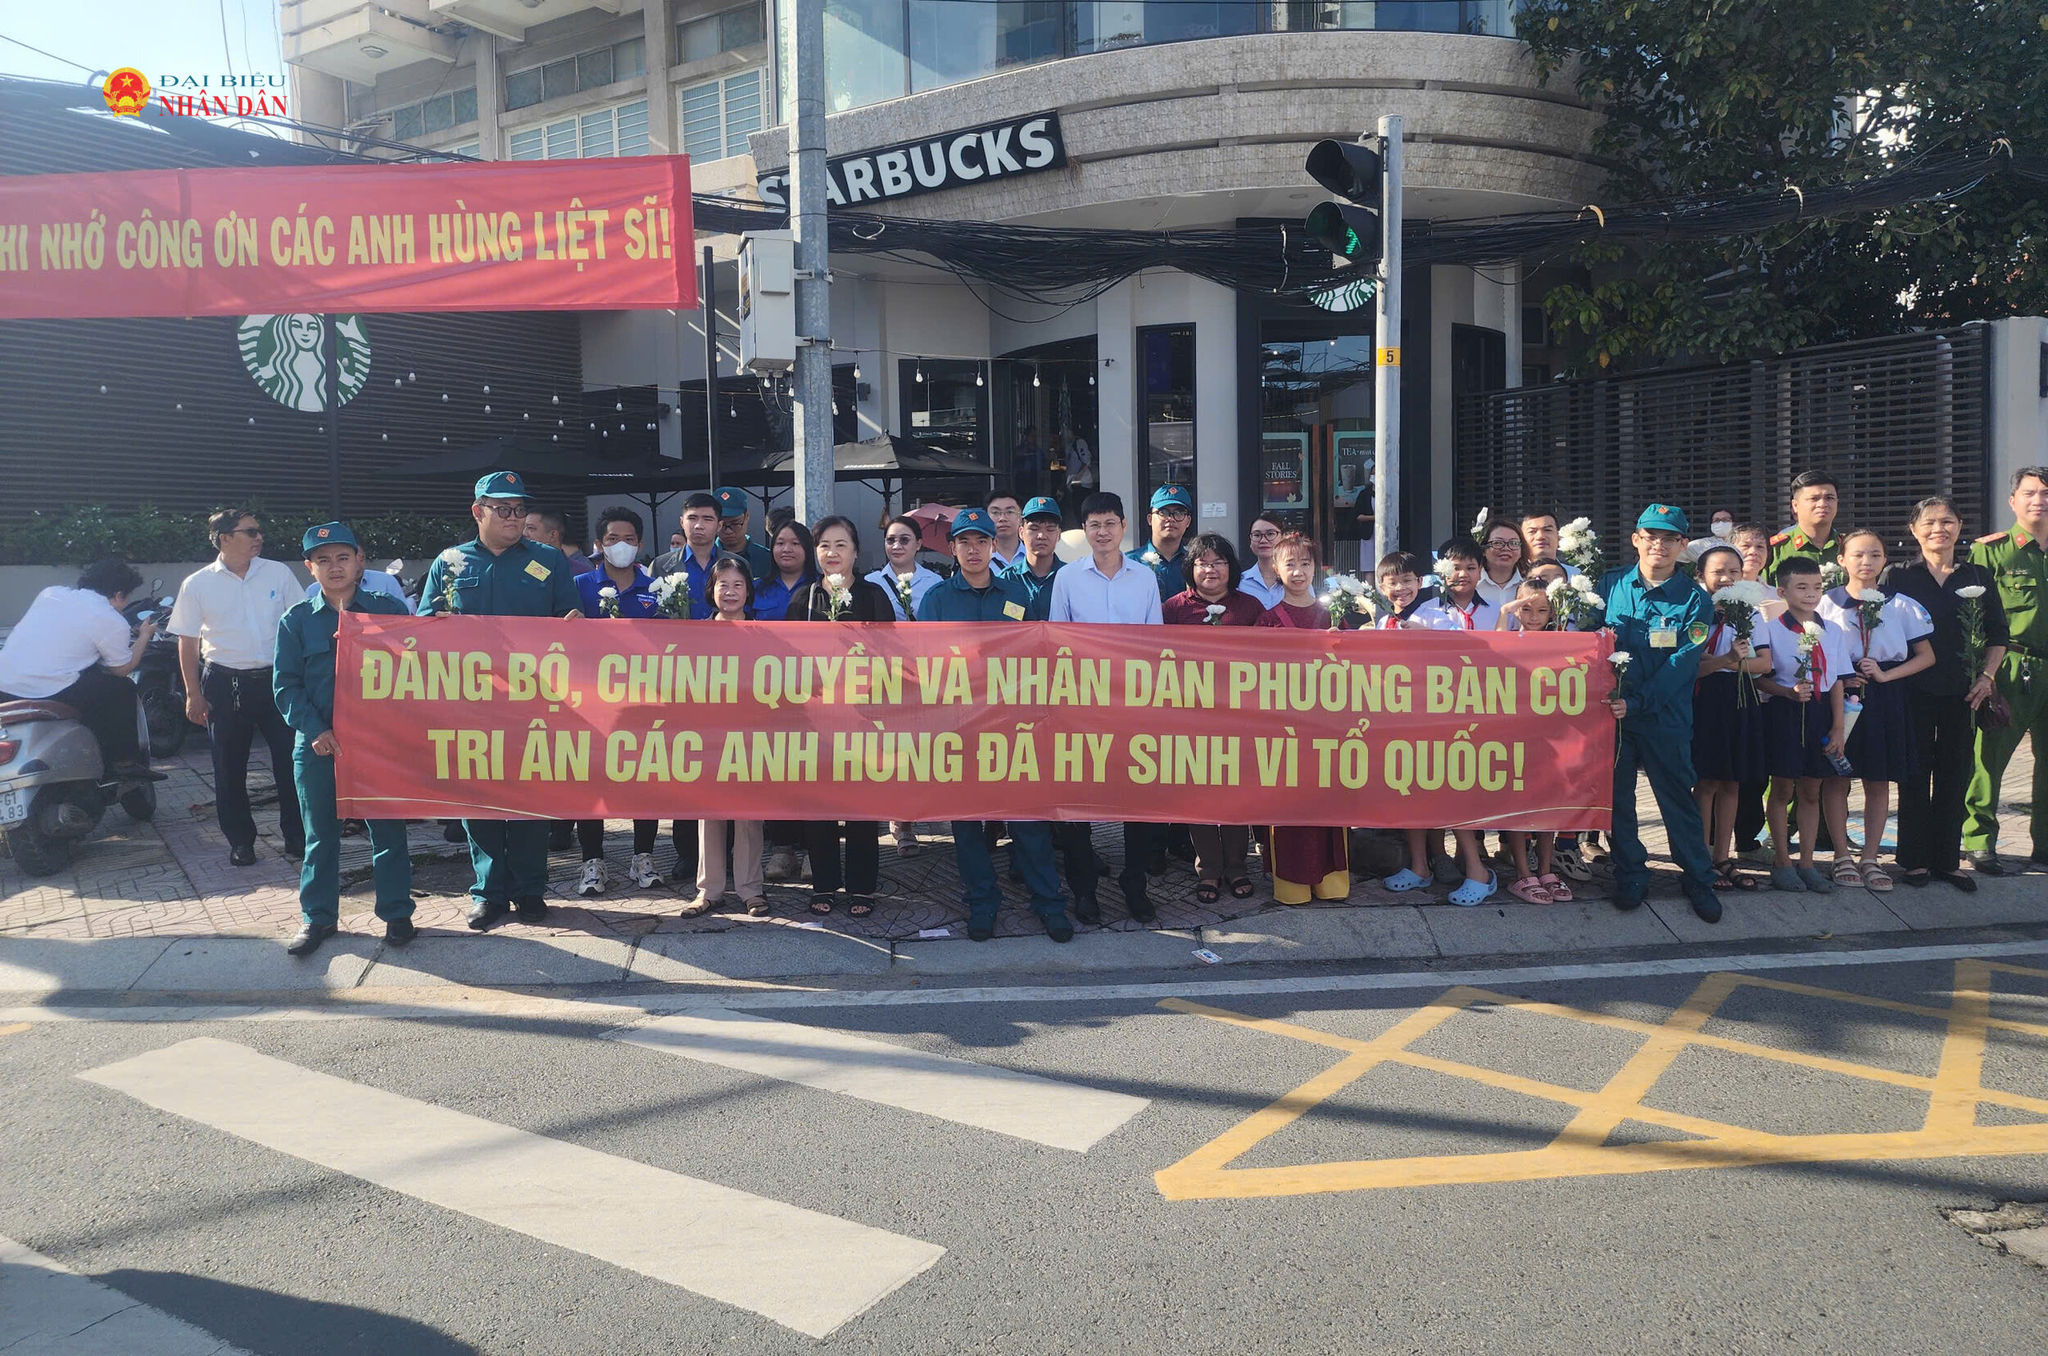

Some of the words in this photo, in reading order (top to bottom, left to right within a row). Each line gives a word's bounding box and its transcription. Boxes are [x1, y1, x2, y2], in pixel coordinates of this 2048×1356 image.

[758, 119, 1055, 213] SARBUCKS
[41, 208, 106, 270] NHỚ
[118, 208, 201, 269] CÔNG
[215, 212, 258, 267] ƠN
[270, 203, 334, 266] CÁC
[349, 215, 414, 264] ANH
[429, 200, 522, 263] HÙNG
[535, 198, 608, 271] LIỆT
[625, 196, 670, 258] SĨ!
[1386, 350, 1394, 363] 5
[1265, 471, 1297, 479] STORIES
[1271, 462, 1290, 471] FALL
[360, 637, 492, 702] ĐẢNG
[508, 643, 581, 712] BỘ,
[598, 644, 739, 704] CHÍNH
[753, 642, 902, 710] QUYỀN
[916, 646, 973, 704] VÀ
[987, 647, 1110, 706] NHÂN
[1125, 650, 1215, 708] DÂN
[1229, 653, 1412, 713] PHƯỜNG
[1426, 656, 1516, 714] BÀN
[1530, 657, 1588, 716] CỜ
[427, 729, 504, 781] TRI
[520, 718, 590, 781] ÂN
[605, 720, 703, 782] CÁC
[717, 731, 818, 782] ANH
[833, 720, 963, 782] HÙNG
[976, 722, 1040, 782] ĐÃ
[1054, 733, 1113, 783] HY
[1128, 734, 1240, 786] SINH
[1254, 726, 1298, 787] VÌ
[1313, 718, 1370, 789] TỔ
[1384, 723, 1524, 796] QUỐC!
